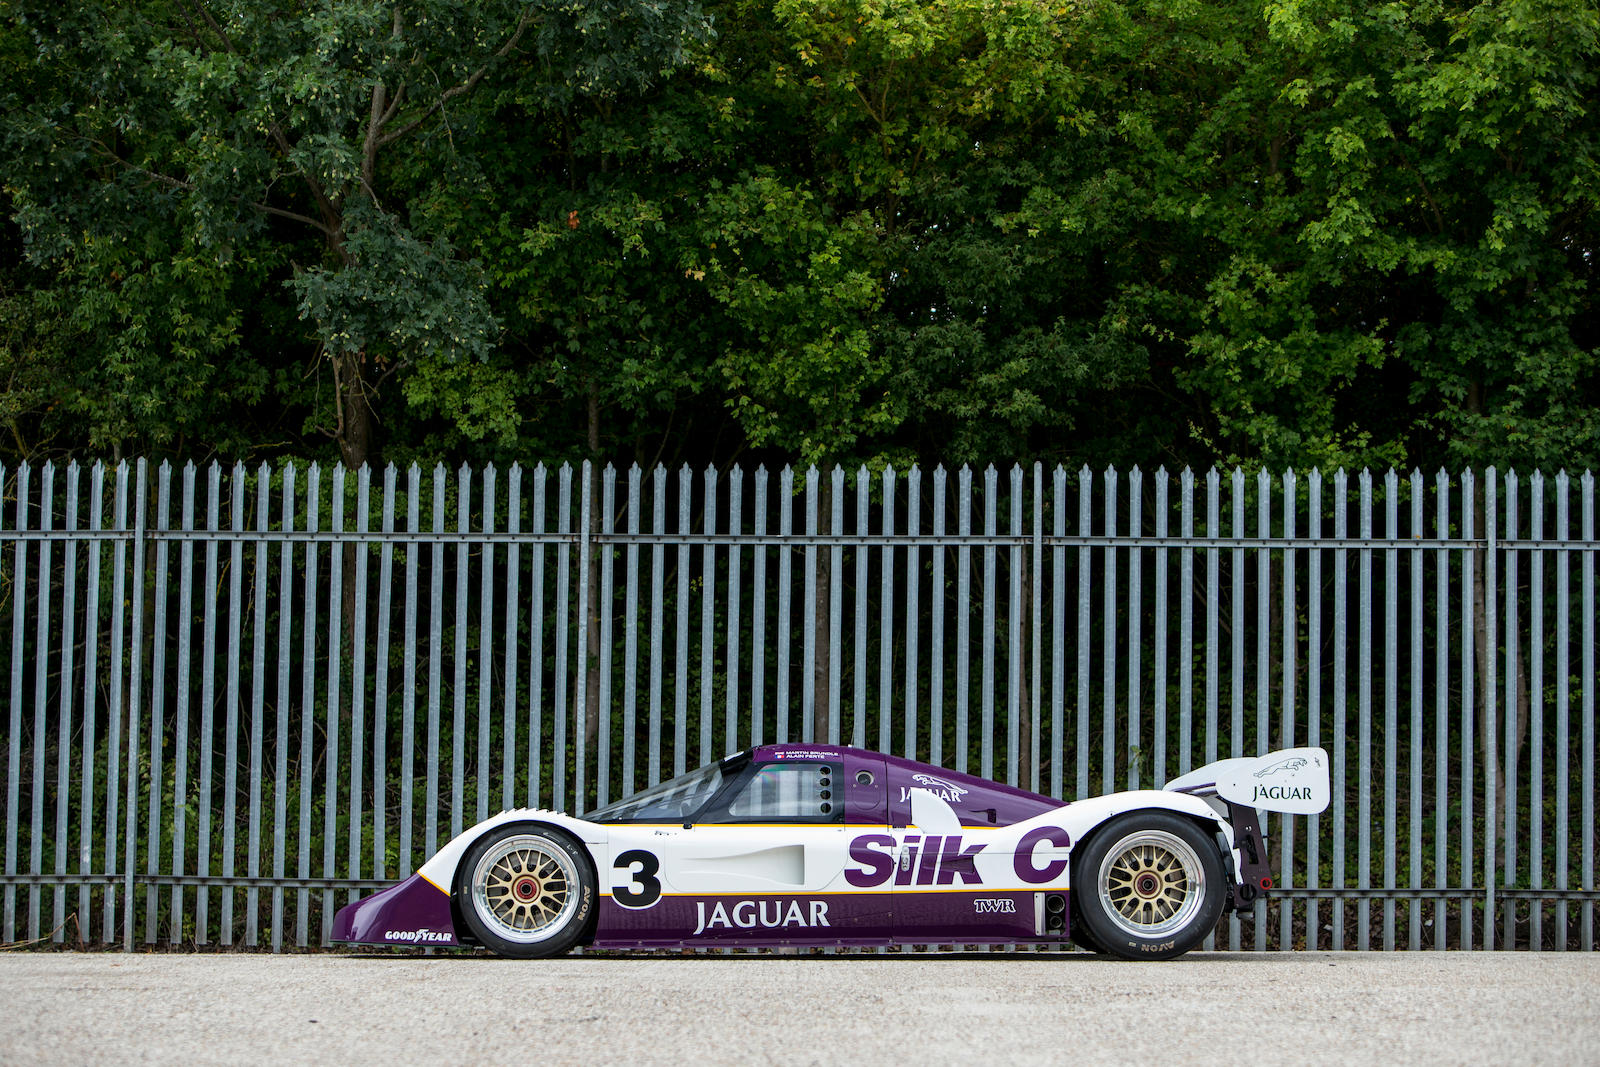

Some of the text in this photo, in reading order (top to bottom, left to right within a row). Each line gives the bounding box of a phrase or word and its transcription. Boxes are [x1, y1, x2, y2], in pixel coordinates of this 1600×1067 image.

[899, 786, 962, 803] JUAR
[1252, 786, 1312, 802] JAGUAR
[844, 834, 989, 888] Silk
[611, 848, 663, 911] 3
[577, 885, 592, 921] AVON
[973, 898, 1017, 914] TWR
[692, 900, 831, 936] JAGUAR
[384, 928, 453, 943] GOODYEAR
[1140, 940, 1175, 953] AVON
